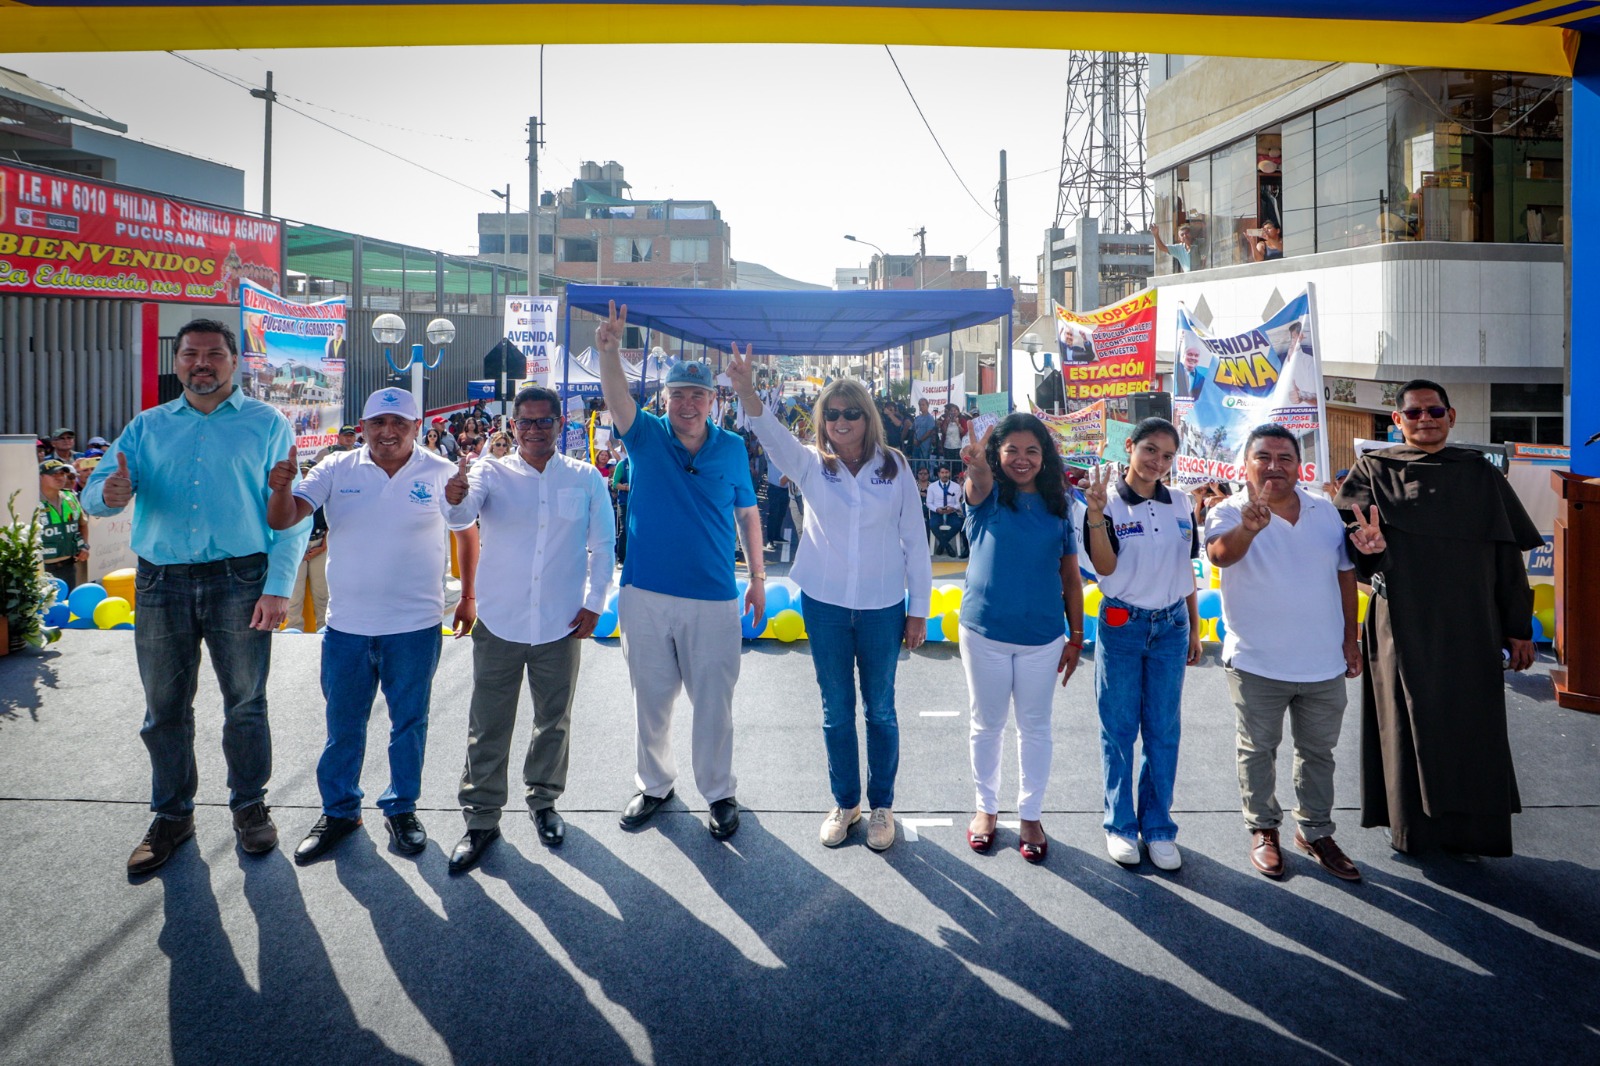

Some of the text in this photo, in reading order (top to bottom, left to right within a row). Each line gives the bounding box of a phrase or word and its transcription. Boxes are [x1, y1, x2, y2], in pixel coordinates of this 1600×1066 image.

[19, 173, 46, 205] I.E.
[72, 184, 107, 215] 6010
[180, 207, 231, 237] CARRILLO
[115, 222, 206, 248] PUCUSANA
[0, 232, 216, 275] BIENVENIDOS
[35, 264, 148, 292] Educación
[151, 279, 182, 295] nos
[523, 304, 553, 313] LIMA
[508, 331, 554, 343] AVENIDA
[521, 345, 547, 357] IMA
[1108, 346, 1137, 355] NUESTRA
[1069, 358, 1145, 381] ESTACIÓN
[576, 384, 599, 392] LIMA
[1207, 460, 1216, 477] Y
